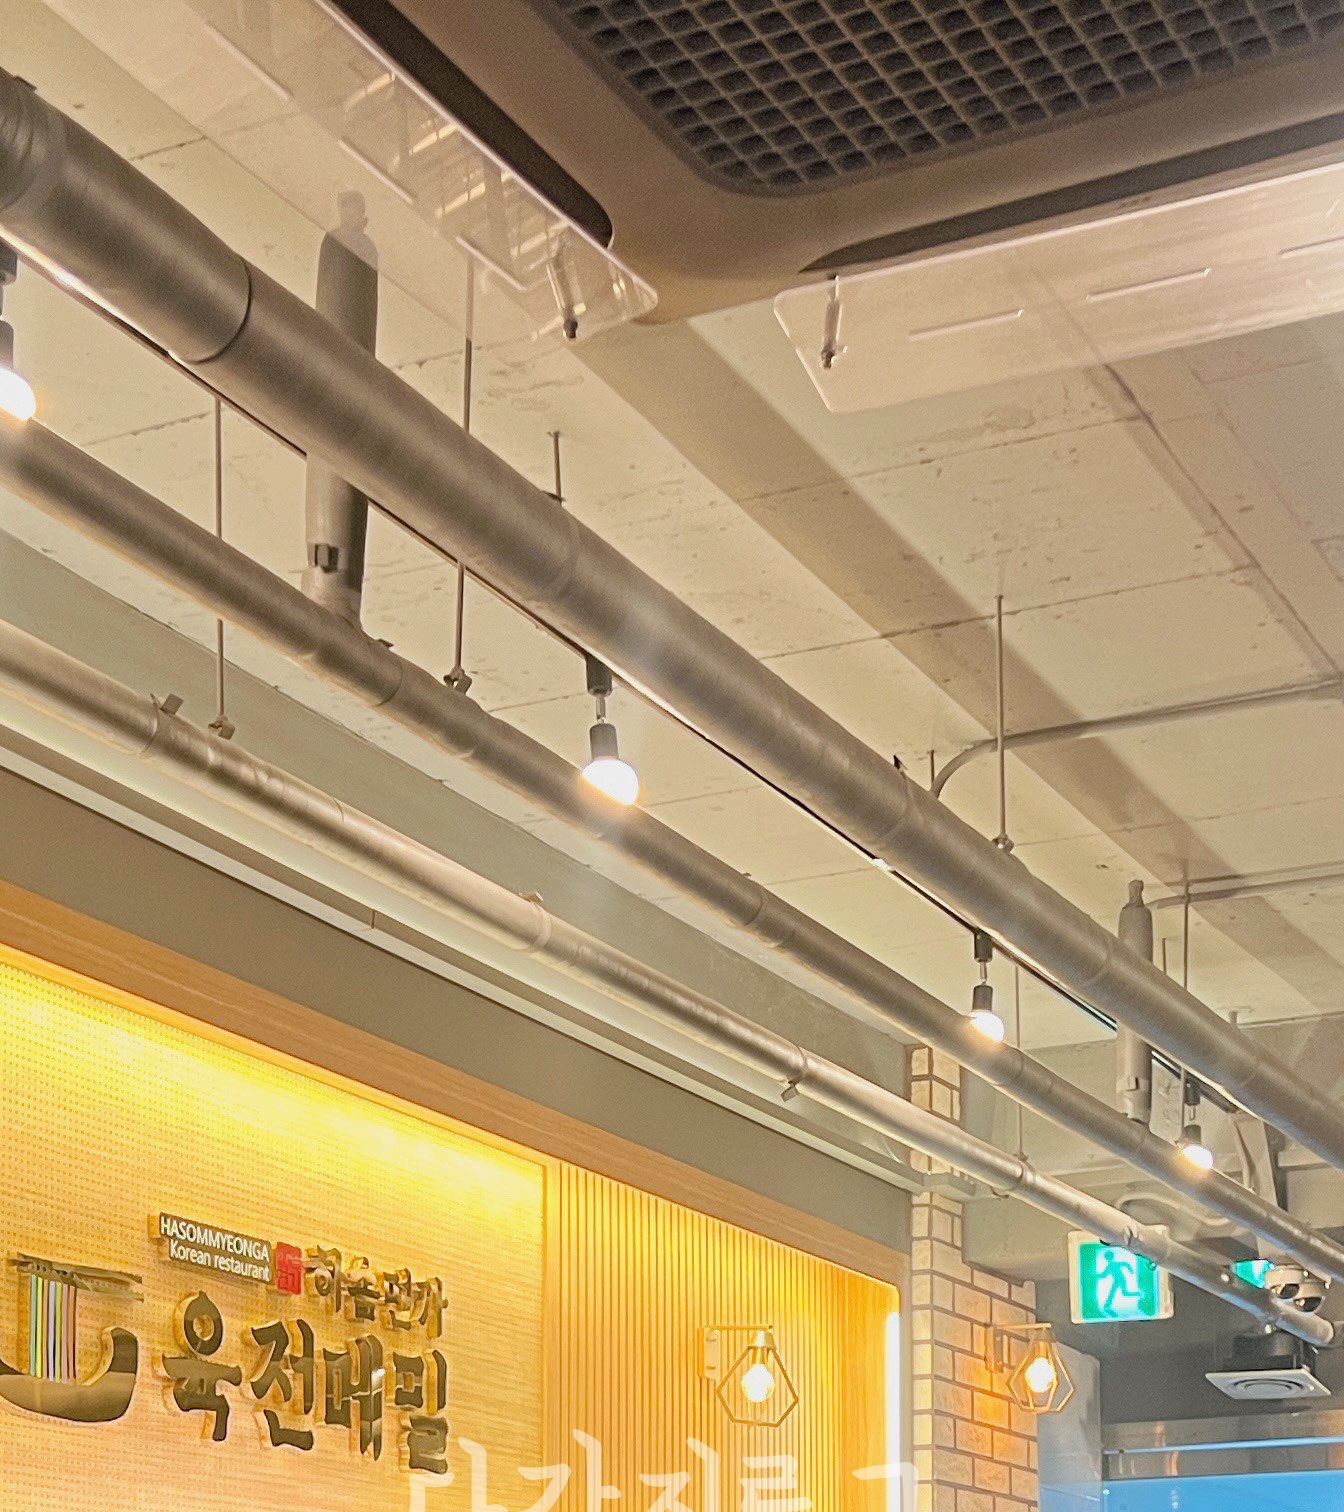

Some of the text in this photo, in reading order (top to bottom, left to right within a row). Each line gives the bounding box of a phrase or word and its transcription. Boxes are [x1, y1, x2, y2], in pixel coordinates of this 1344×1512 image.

[160, 1216, 270, 1262] HASOMMYEONGA
[170, 1240, 211, 1267] Korean
[213, 1252, 270, 1282] restaurant
[303, 1244, 449, 1339] 하솜면가
[159, 1290, 449, 1475] 육전메밀
